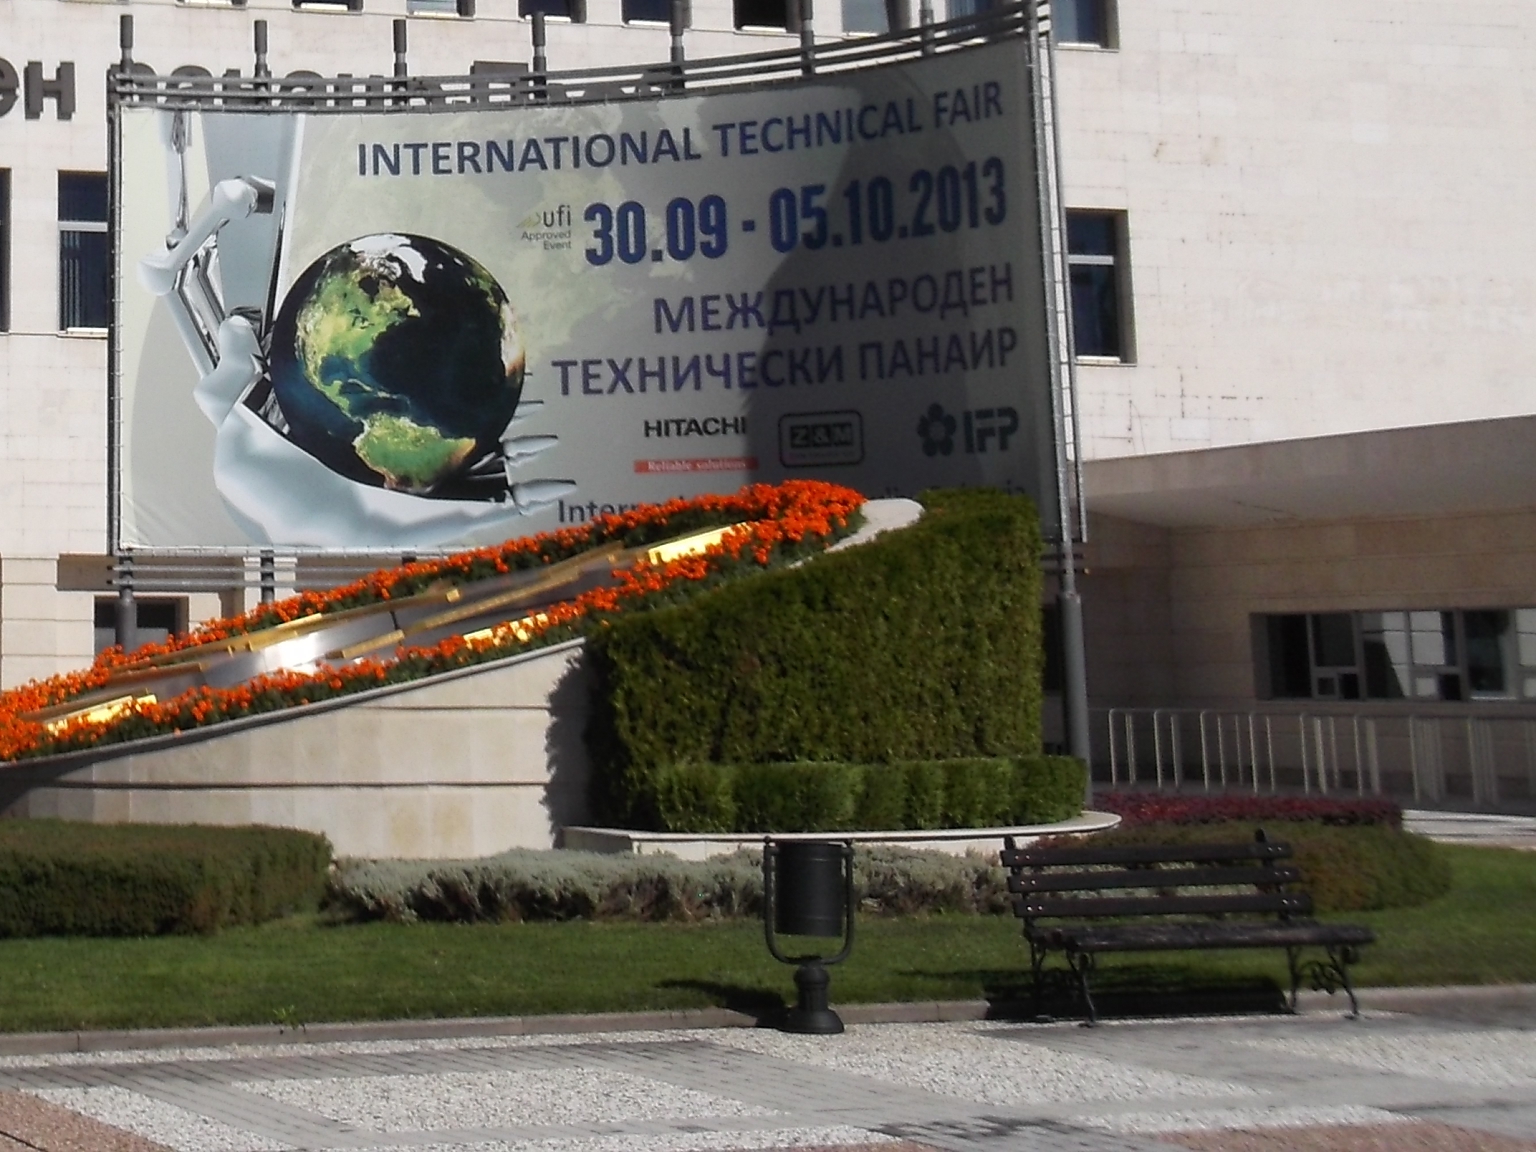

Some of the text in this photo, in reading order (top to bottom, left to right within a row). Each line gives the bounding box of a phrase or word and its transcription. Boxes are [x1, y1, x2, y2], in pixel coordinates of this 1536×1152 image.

[357, 81, 1003, 176] INTERNATIONAL TECHNICAL FAIR
[543, 204, 571, 227] ufi
[584, 194, 728, 266] 30.09
[768, 156, 1006, 253] 05.10.2013
[521, 230, 572, 242] Approved
[543, 239, 572, 251] Event
[653, 261, 1014, 336] МЕЖДУНАРОДЕН
[551, 326, 1017, 396] ТЕХНИЧЕСКИ ПАНАИР
[643, 416, 747, 438] HITACHI
[963, 406, 1020, 455] IFP
